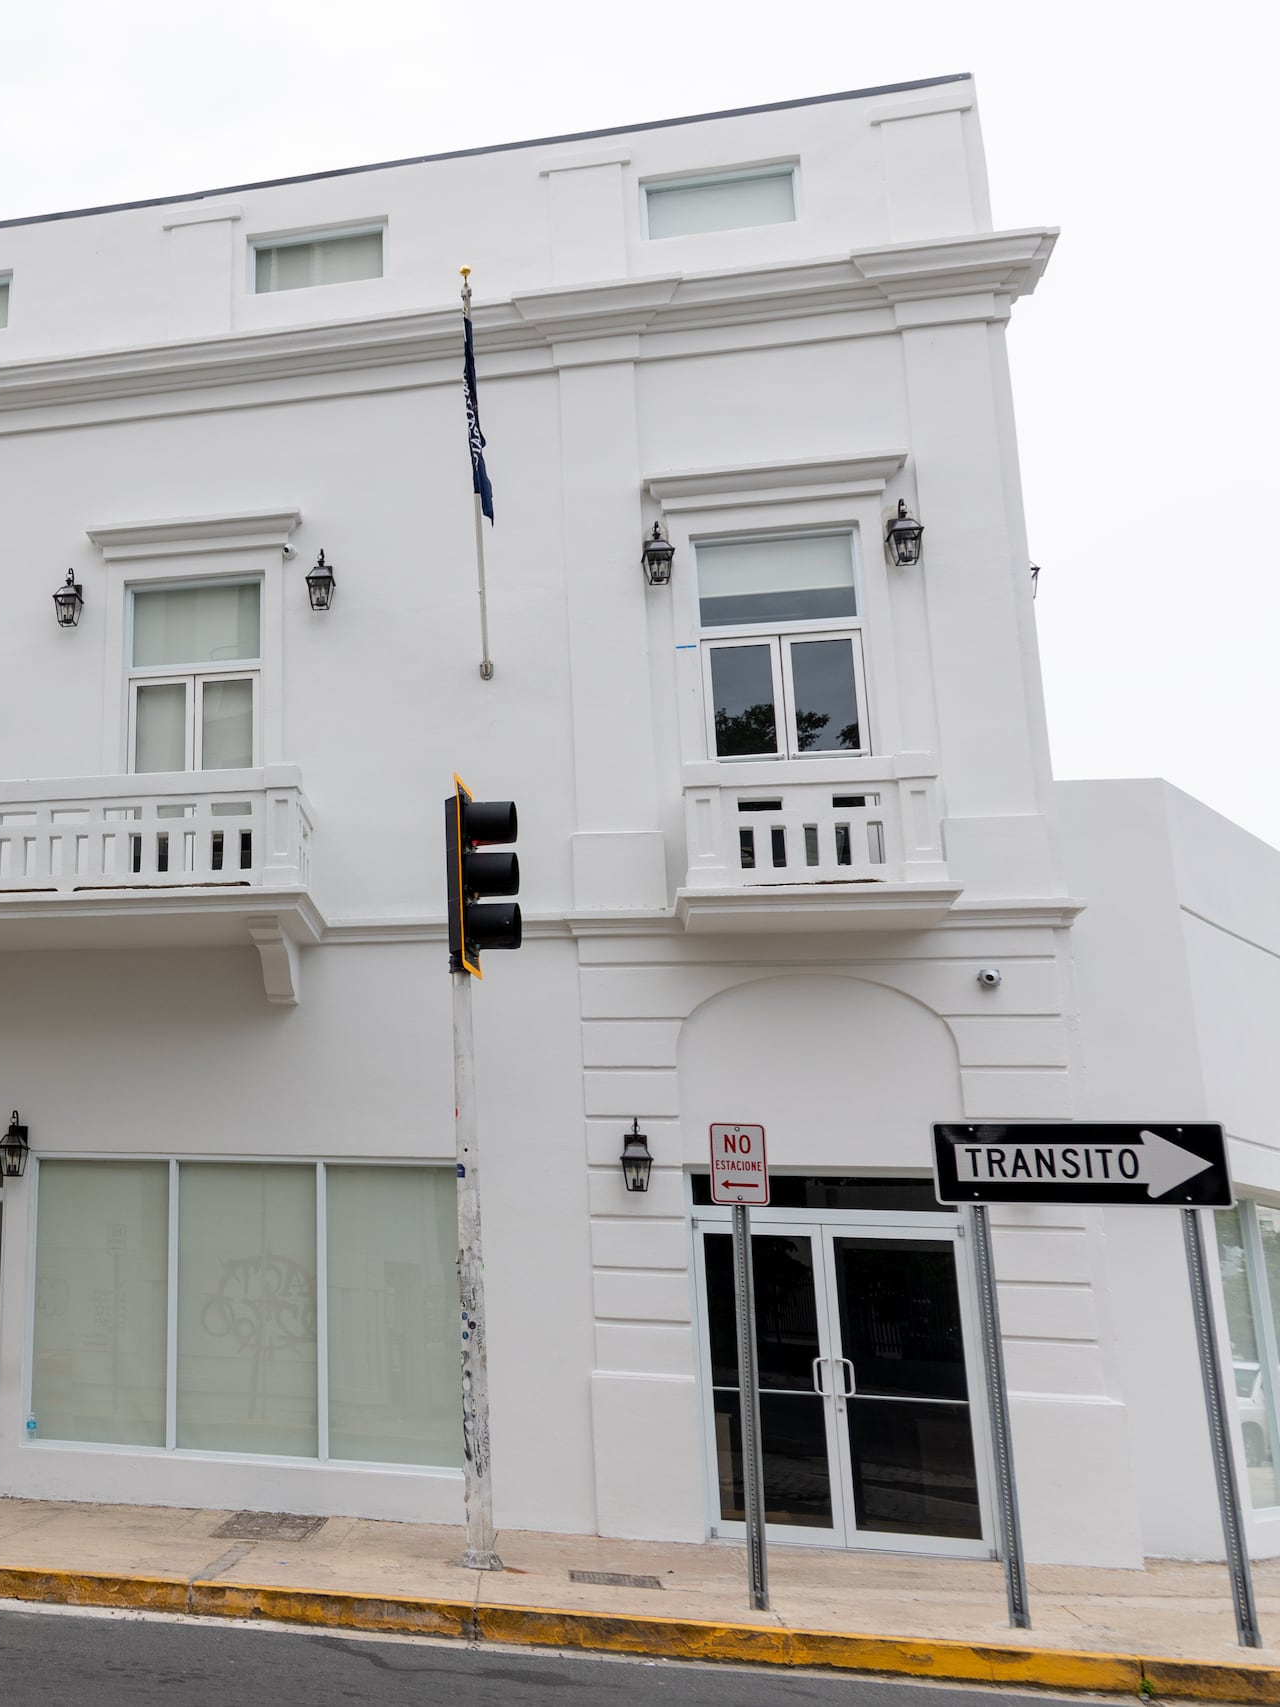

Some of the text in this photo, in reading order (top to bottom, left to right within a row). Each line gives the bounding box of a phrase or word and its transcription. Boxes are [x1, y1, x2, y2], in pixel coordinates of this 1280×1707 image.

[723, 1134, 752, 1154] NO
[715, 1159, 763, 1173] ESTACIONE
[964, 1147, 1140, 1180] TRANSITO
